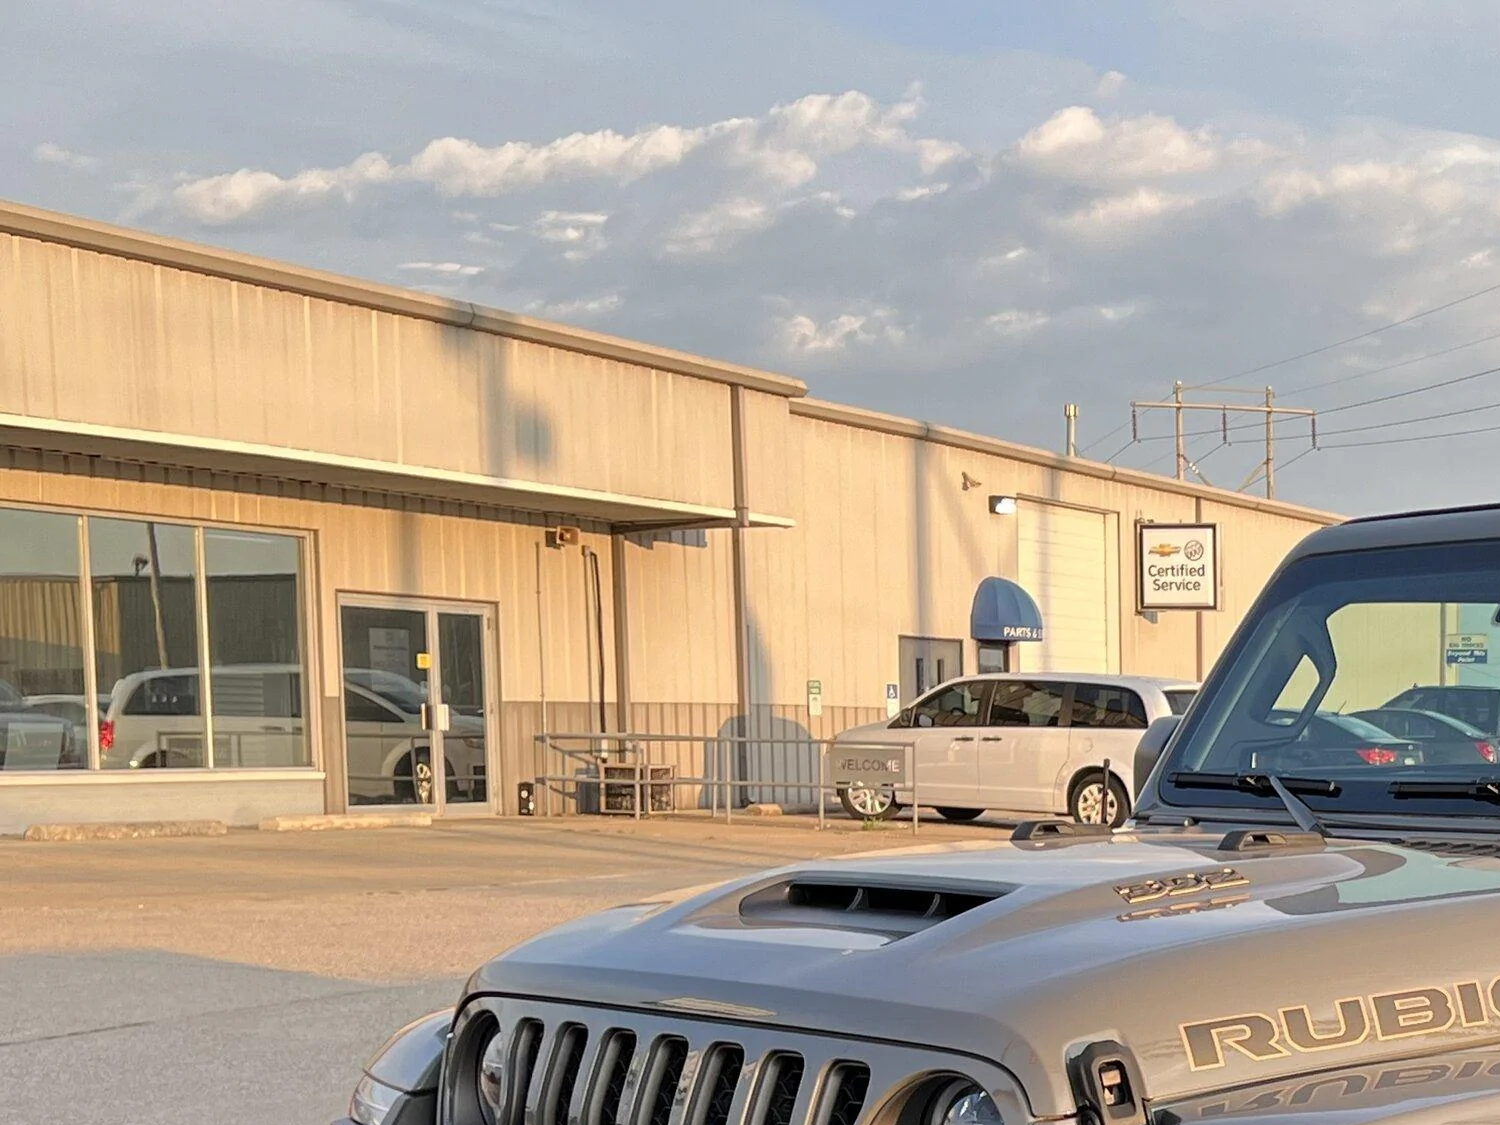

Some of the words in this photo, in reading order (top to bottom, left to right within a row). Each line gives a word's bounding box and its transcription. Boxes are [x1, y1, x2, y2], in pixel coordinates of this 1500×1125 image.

[1147, 563, 1205, 577] Certified
[1152, 579, 1201, 591] Service
[1003, 626, 1031, 638] PARTS
[838, 758, 900, 772] WELCOME
